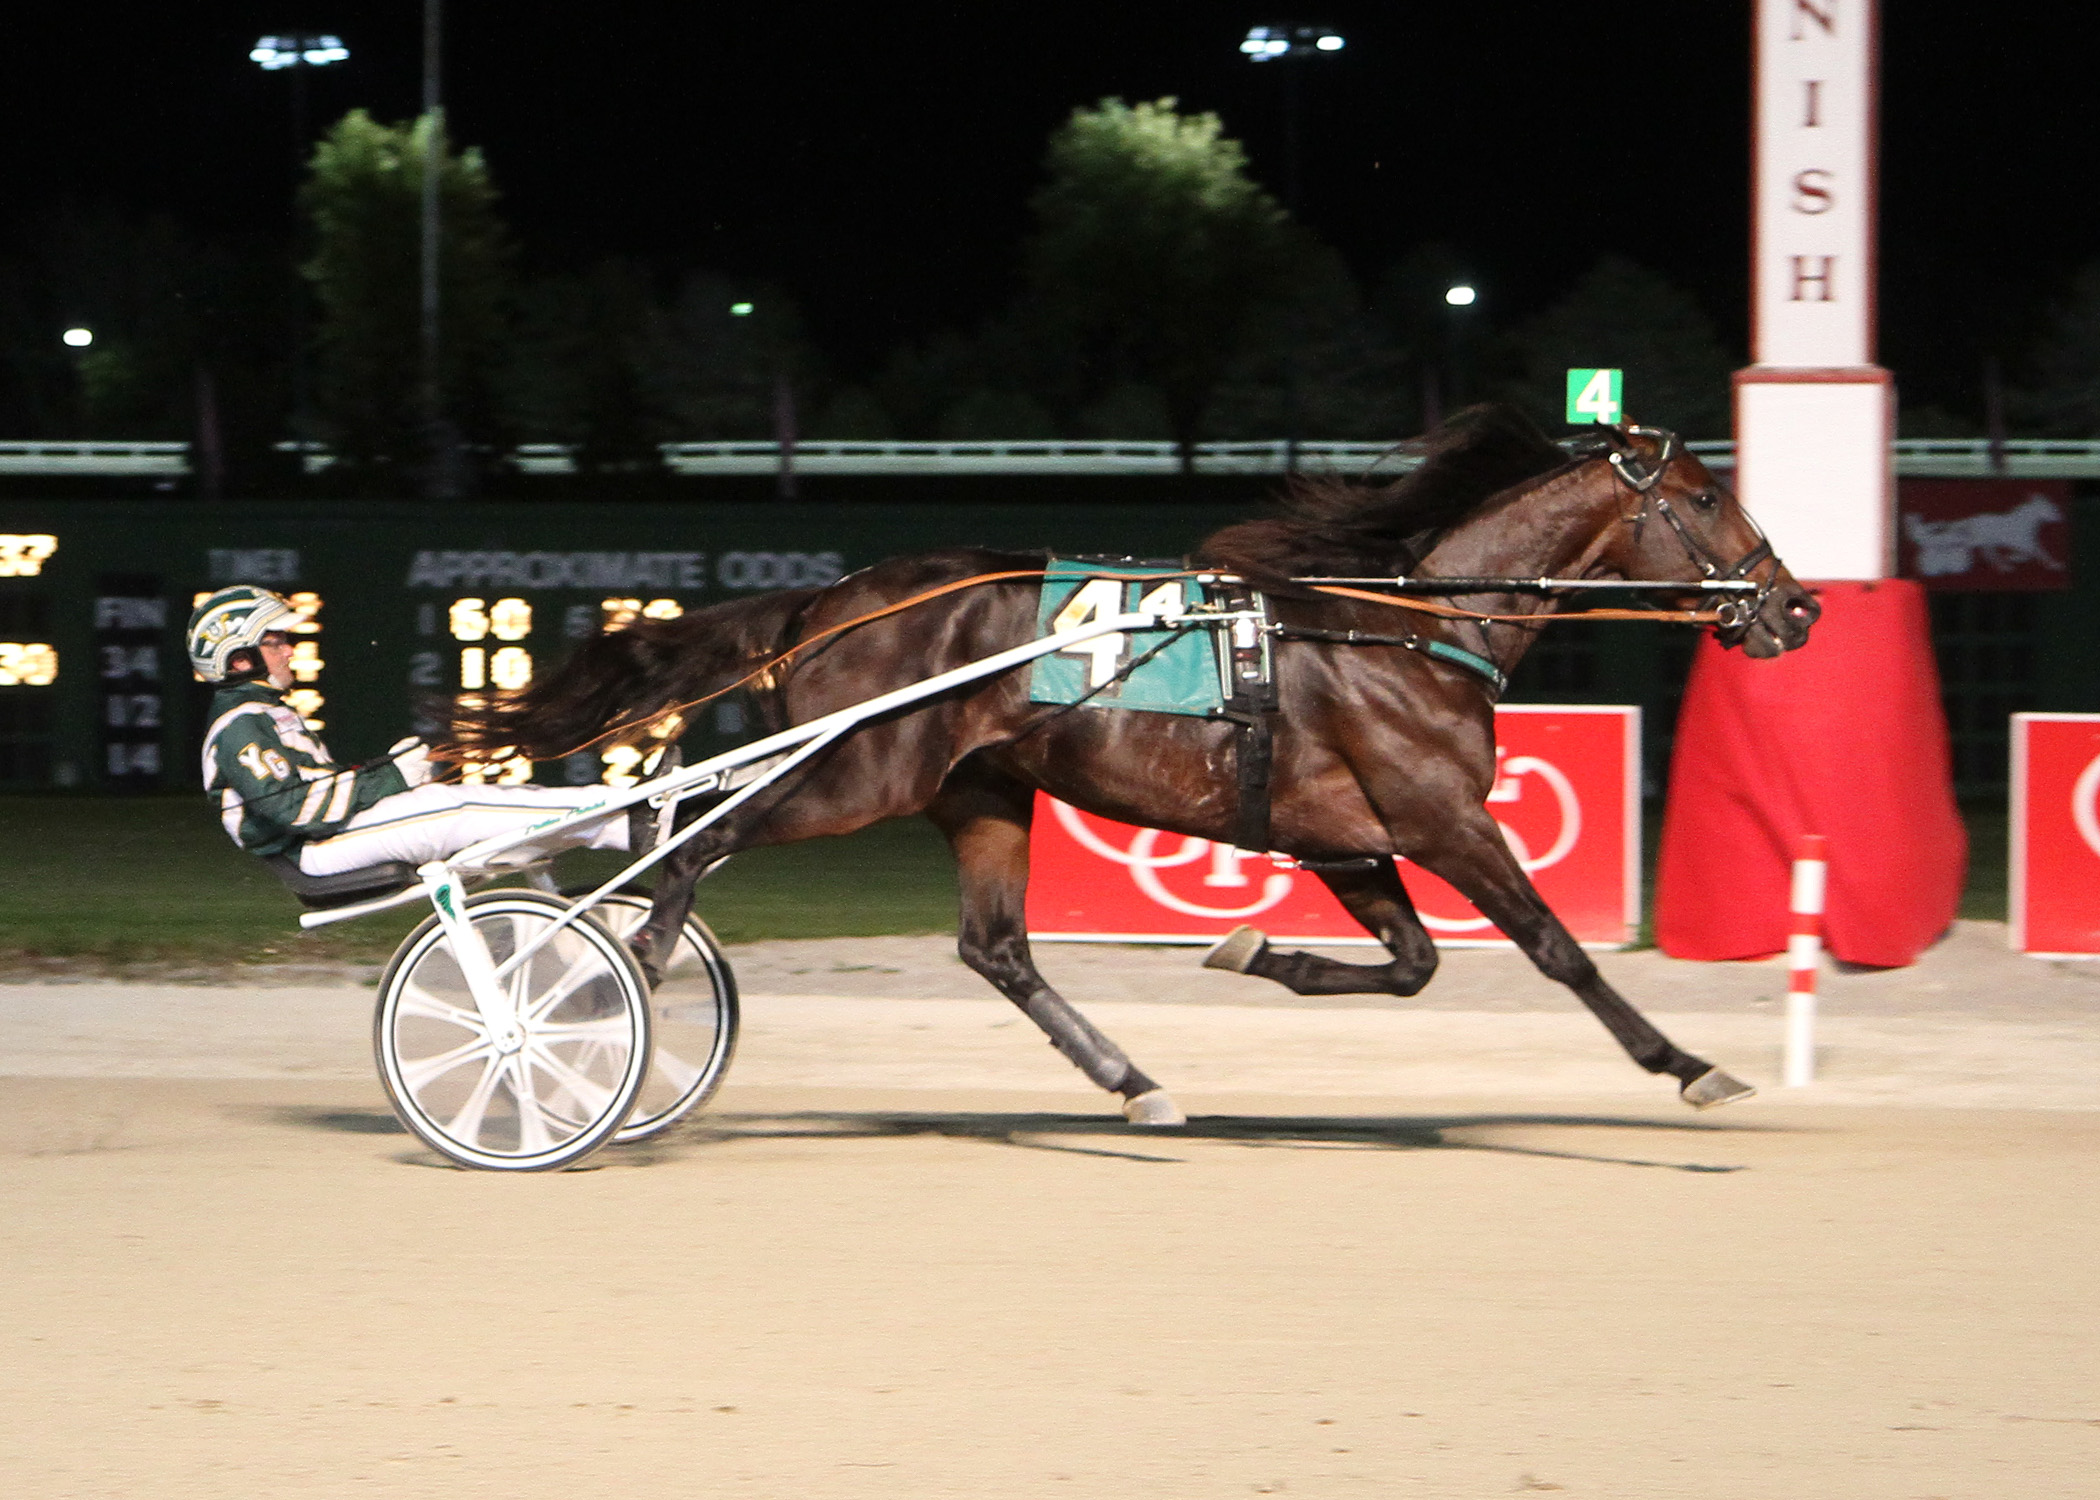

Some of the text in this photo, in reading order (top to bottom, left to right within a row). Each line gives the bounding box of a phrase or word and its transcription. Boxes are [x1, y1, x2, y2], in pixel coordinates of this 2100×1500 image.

[1576, 369, 1617, 422] 4
[406, 551, 846, 588] APPROXIMATE ODDS
[448, 597, 532, 641] 60
[1053, 579, 1125, 688] 4
[461, 646, 532, 690] 10
